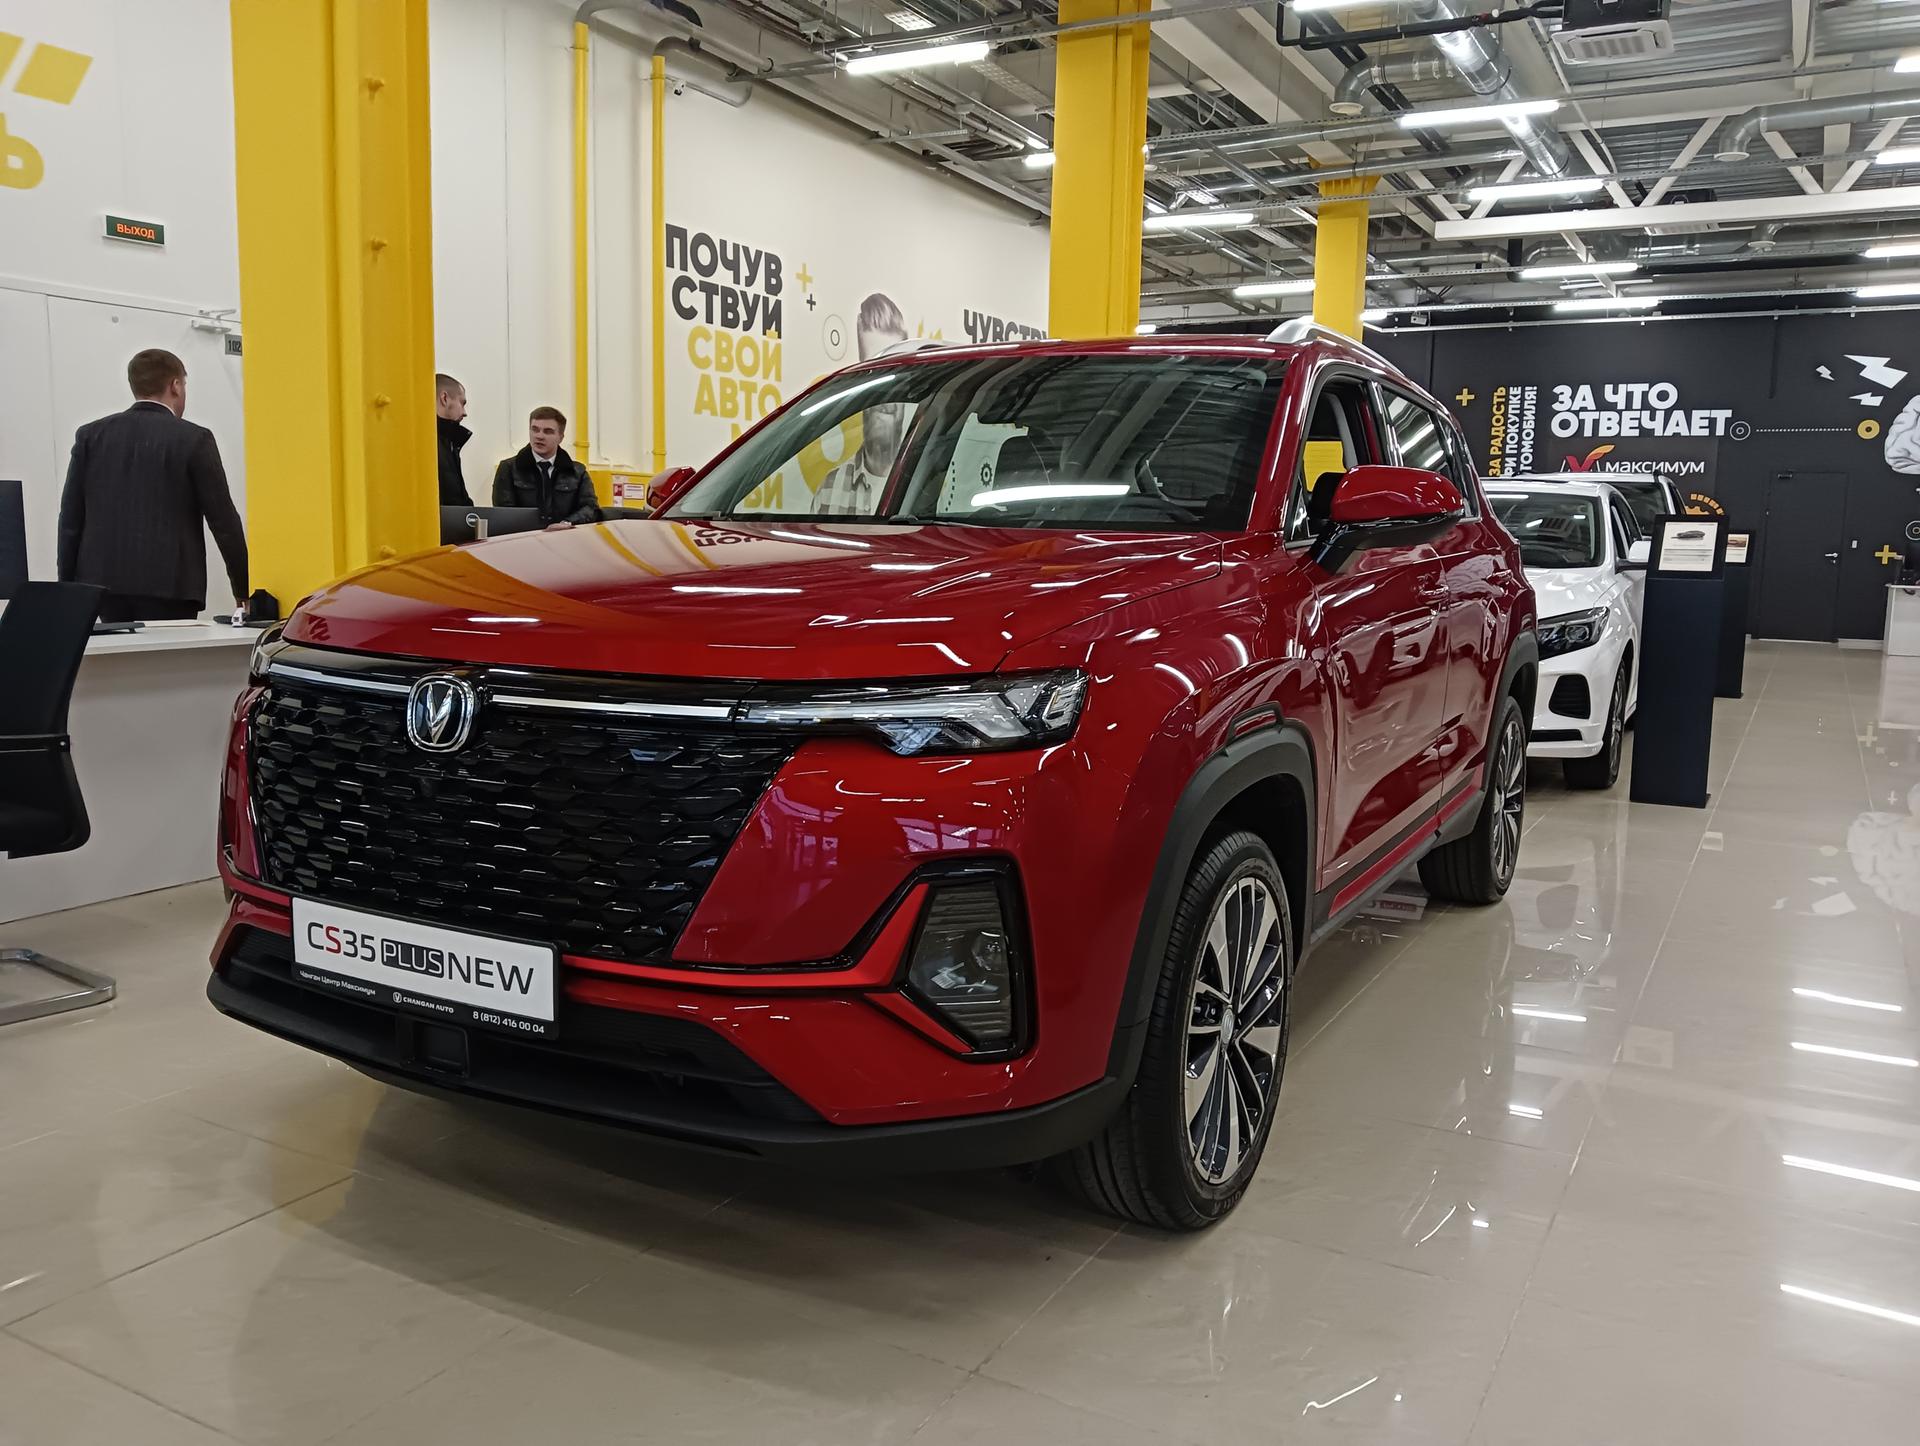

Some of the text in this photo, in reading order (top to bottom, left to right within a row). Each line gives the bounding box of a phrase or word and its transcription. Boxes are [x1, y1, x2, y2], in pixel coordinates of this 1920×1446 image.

[116, 223, 155, 240] ВЫХОД
[665, 223, 783, 297] ПОЧУВ
[672, 274, 782, 339] СТВУЙ
[963, 308, 1047, 344] ЧУВСТ
[687, 325, 782, 382] СВОЙ
[693, 373, 782, 421] АВТО
[1551, 382, 1678, 412] ЗА ЧТО
[1488, 386, 1506, 477] ЗА РАДОСТЬ
[1504, 386, 1521, 478] РИ ПОКУПКЕ
[1519, 386, 1538, 471] ТОМОБИЛЯ!
[1550, 409, 1733, 438] ОТВЕЧАЕТ
[307, 921, 535, 995] CS35 PLUS NEW
[402, 996, 454, 1014] CHANGAN AUTO
[472, 1010, 545, 1034] 8 (812) 416 00 04
